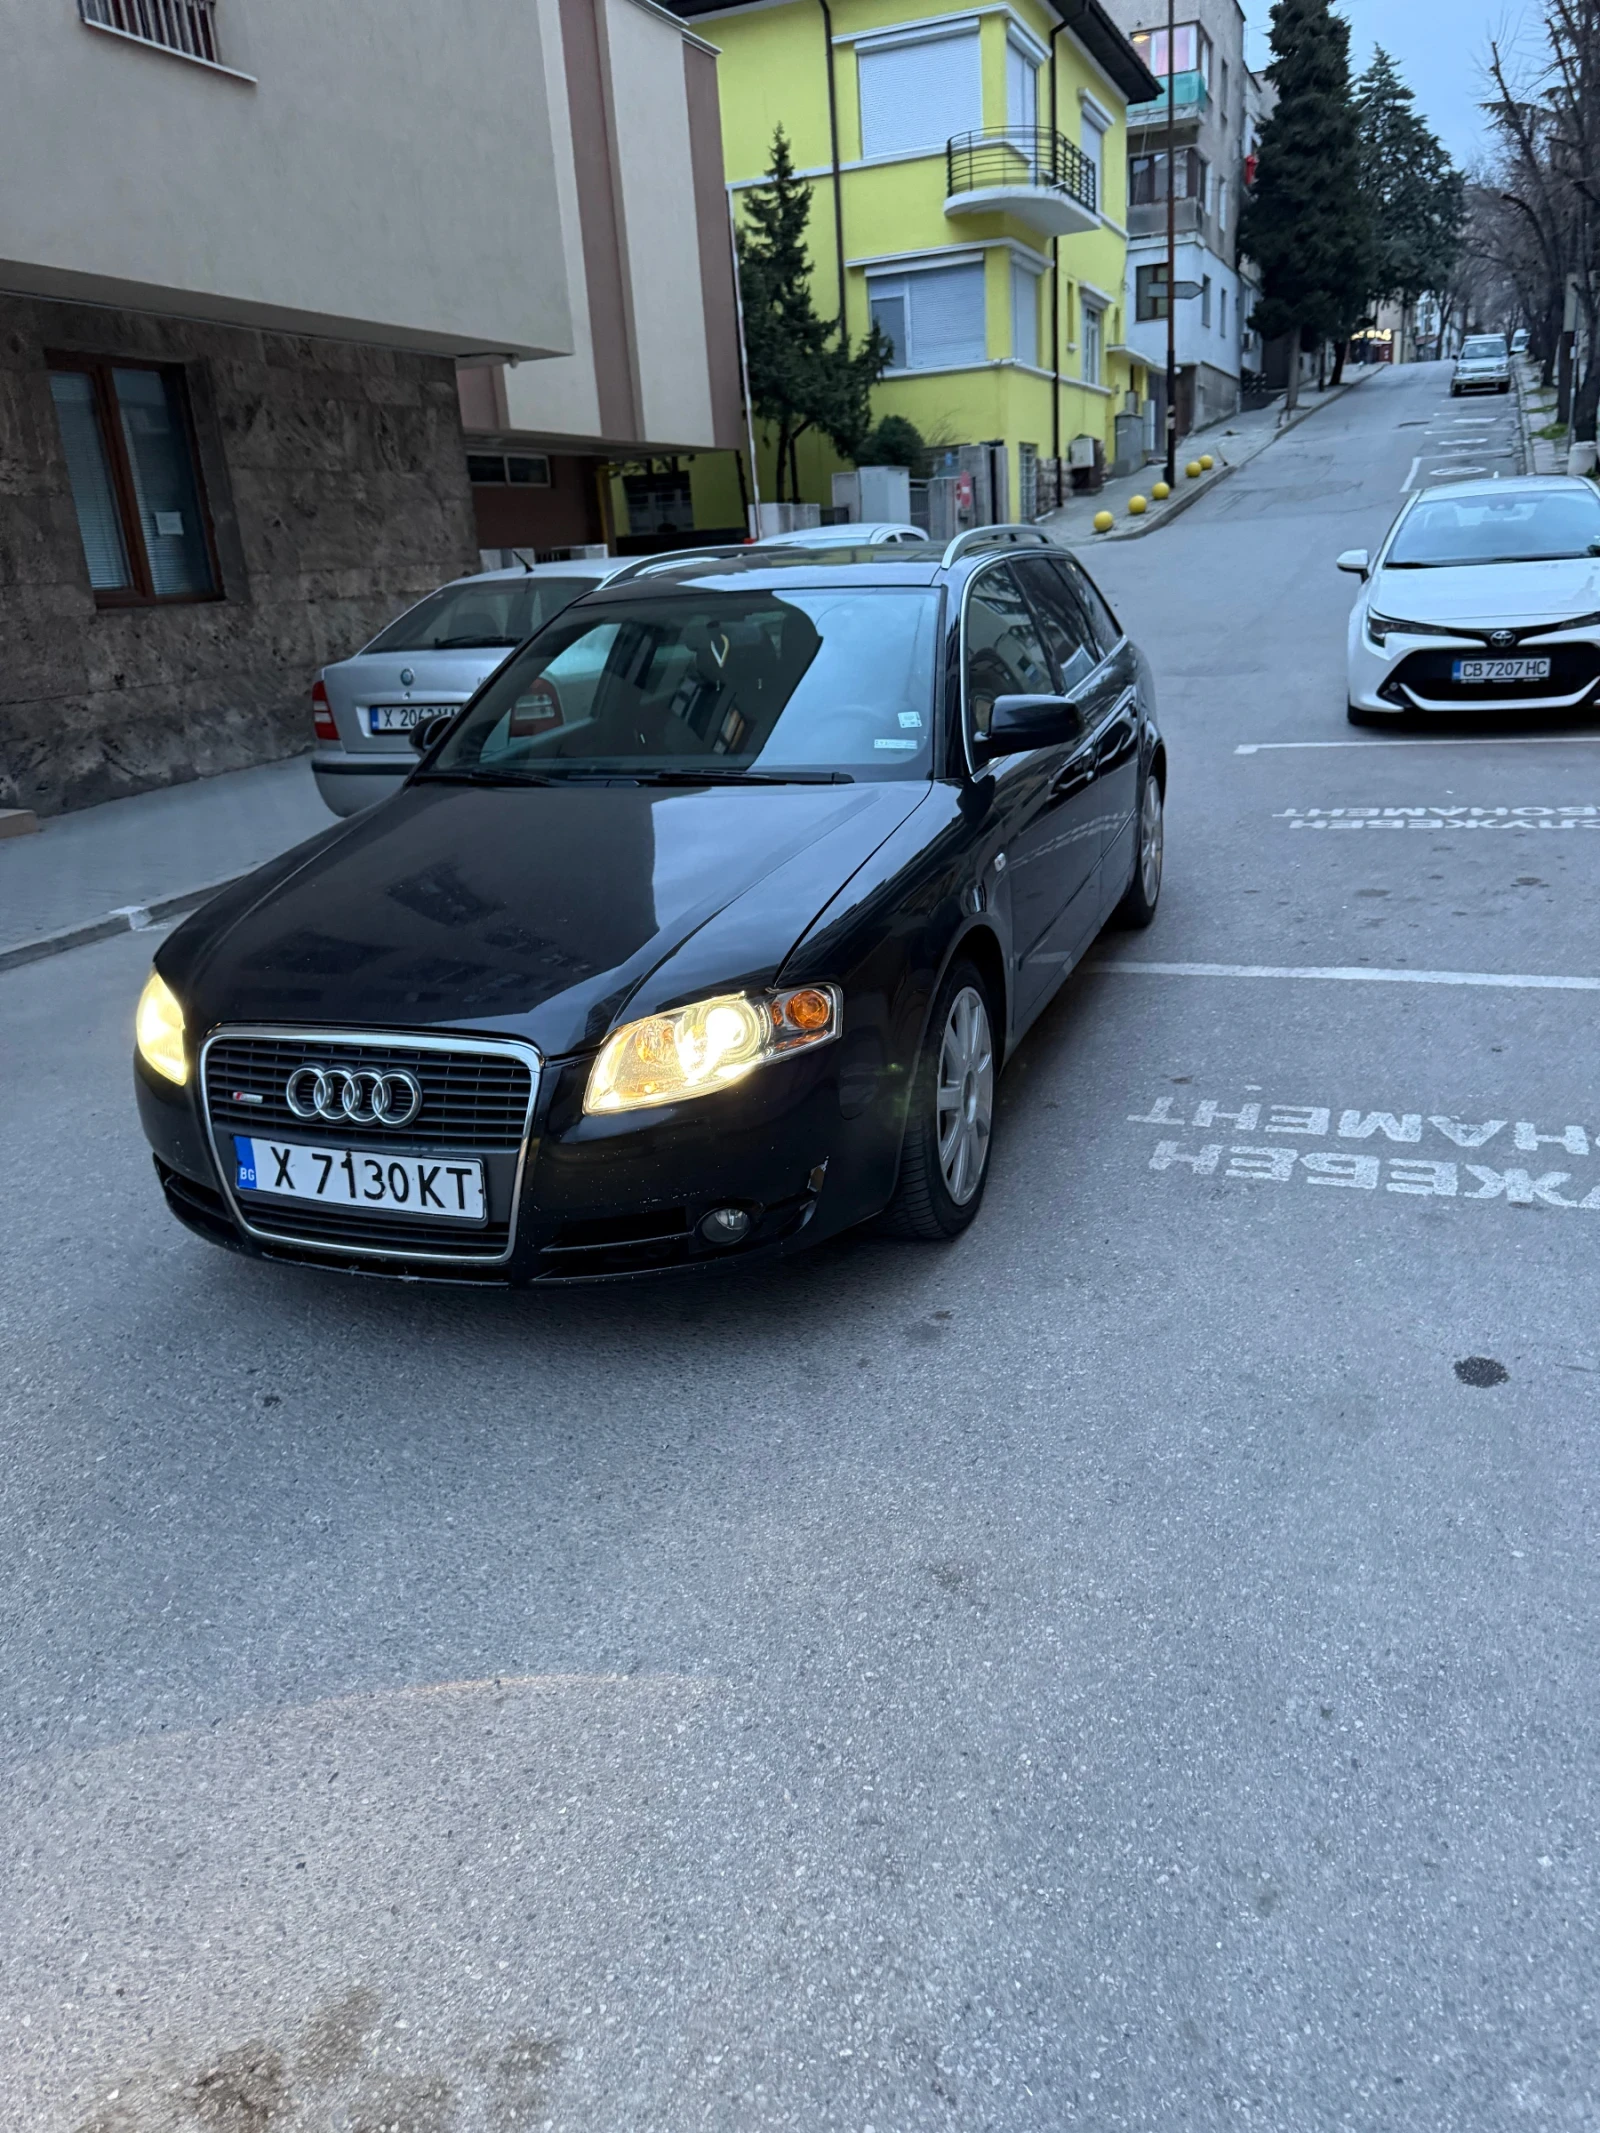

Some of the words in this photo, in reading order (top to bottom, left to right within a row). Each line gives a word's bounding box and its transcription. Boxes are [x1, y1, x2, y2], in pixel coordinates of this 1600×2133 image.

[1463, 663, 1483, 677] CB
[1486, 661, 1524, 676] 7207
[1525, 660, 1547, 675] HC
[384, 709, 393, 727] X
[1271, 805, 1600, 818] БОНАМЕНТ
[1126, 1096, 1600, 1156] НАМЕНТ
[239, 1167, 256, 1182] BG
[270, 1146, 296, 1190] X
[311, 1152, 410, 1204] 7130
[417, 1164, 473, 1210] KT
